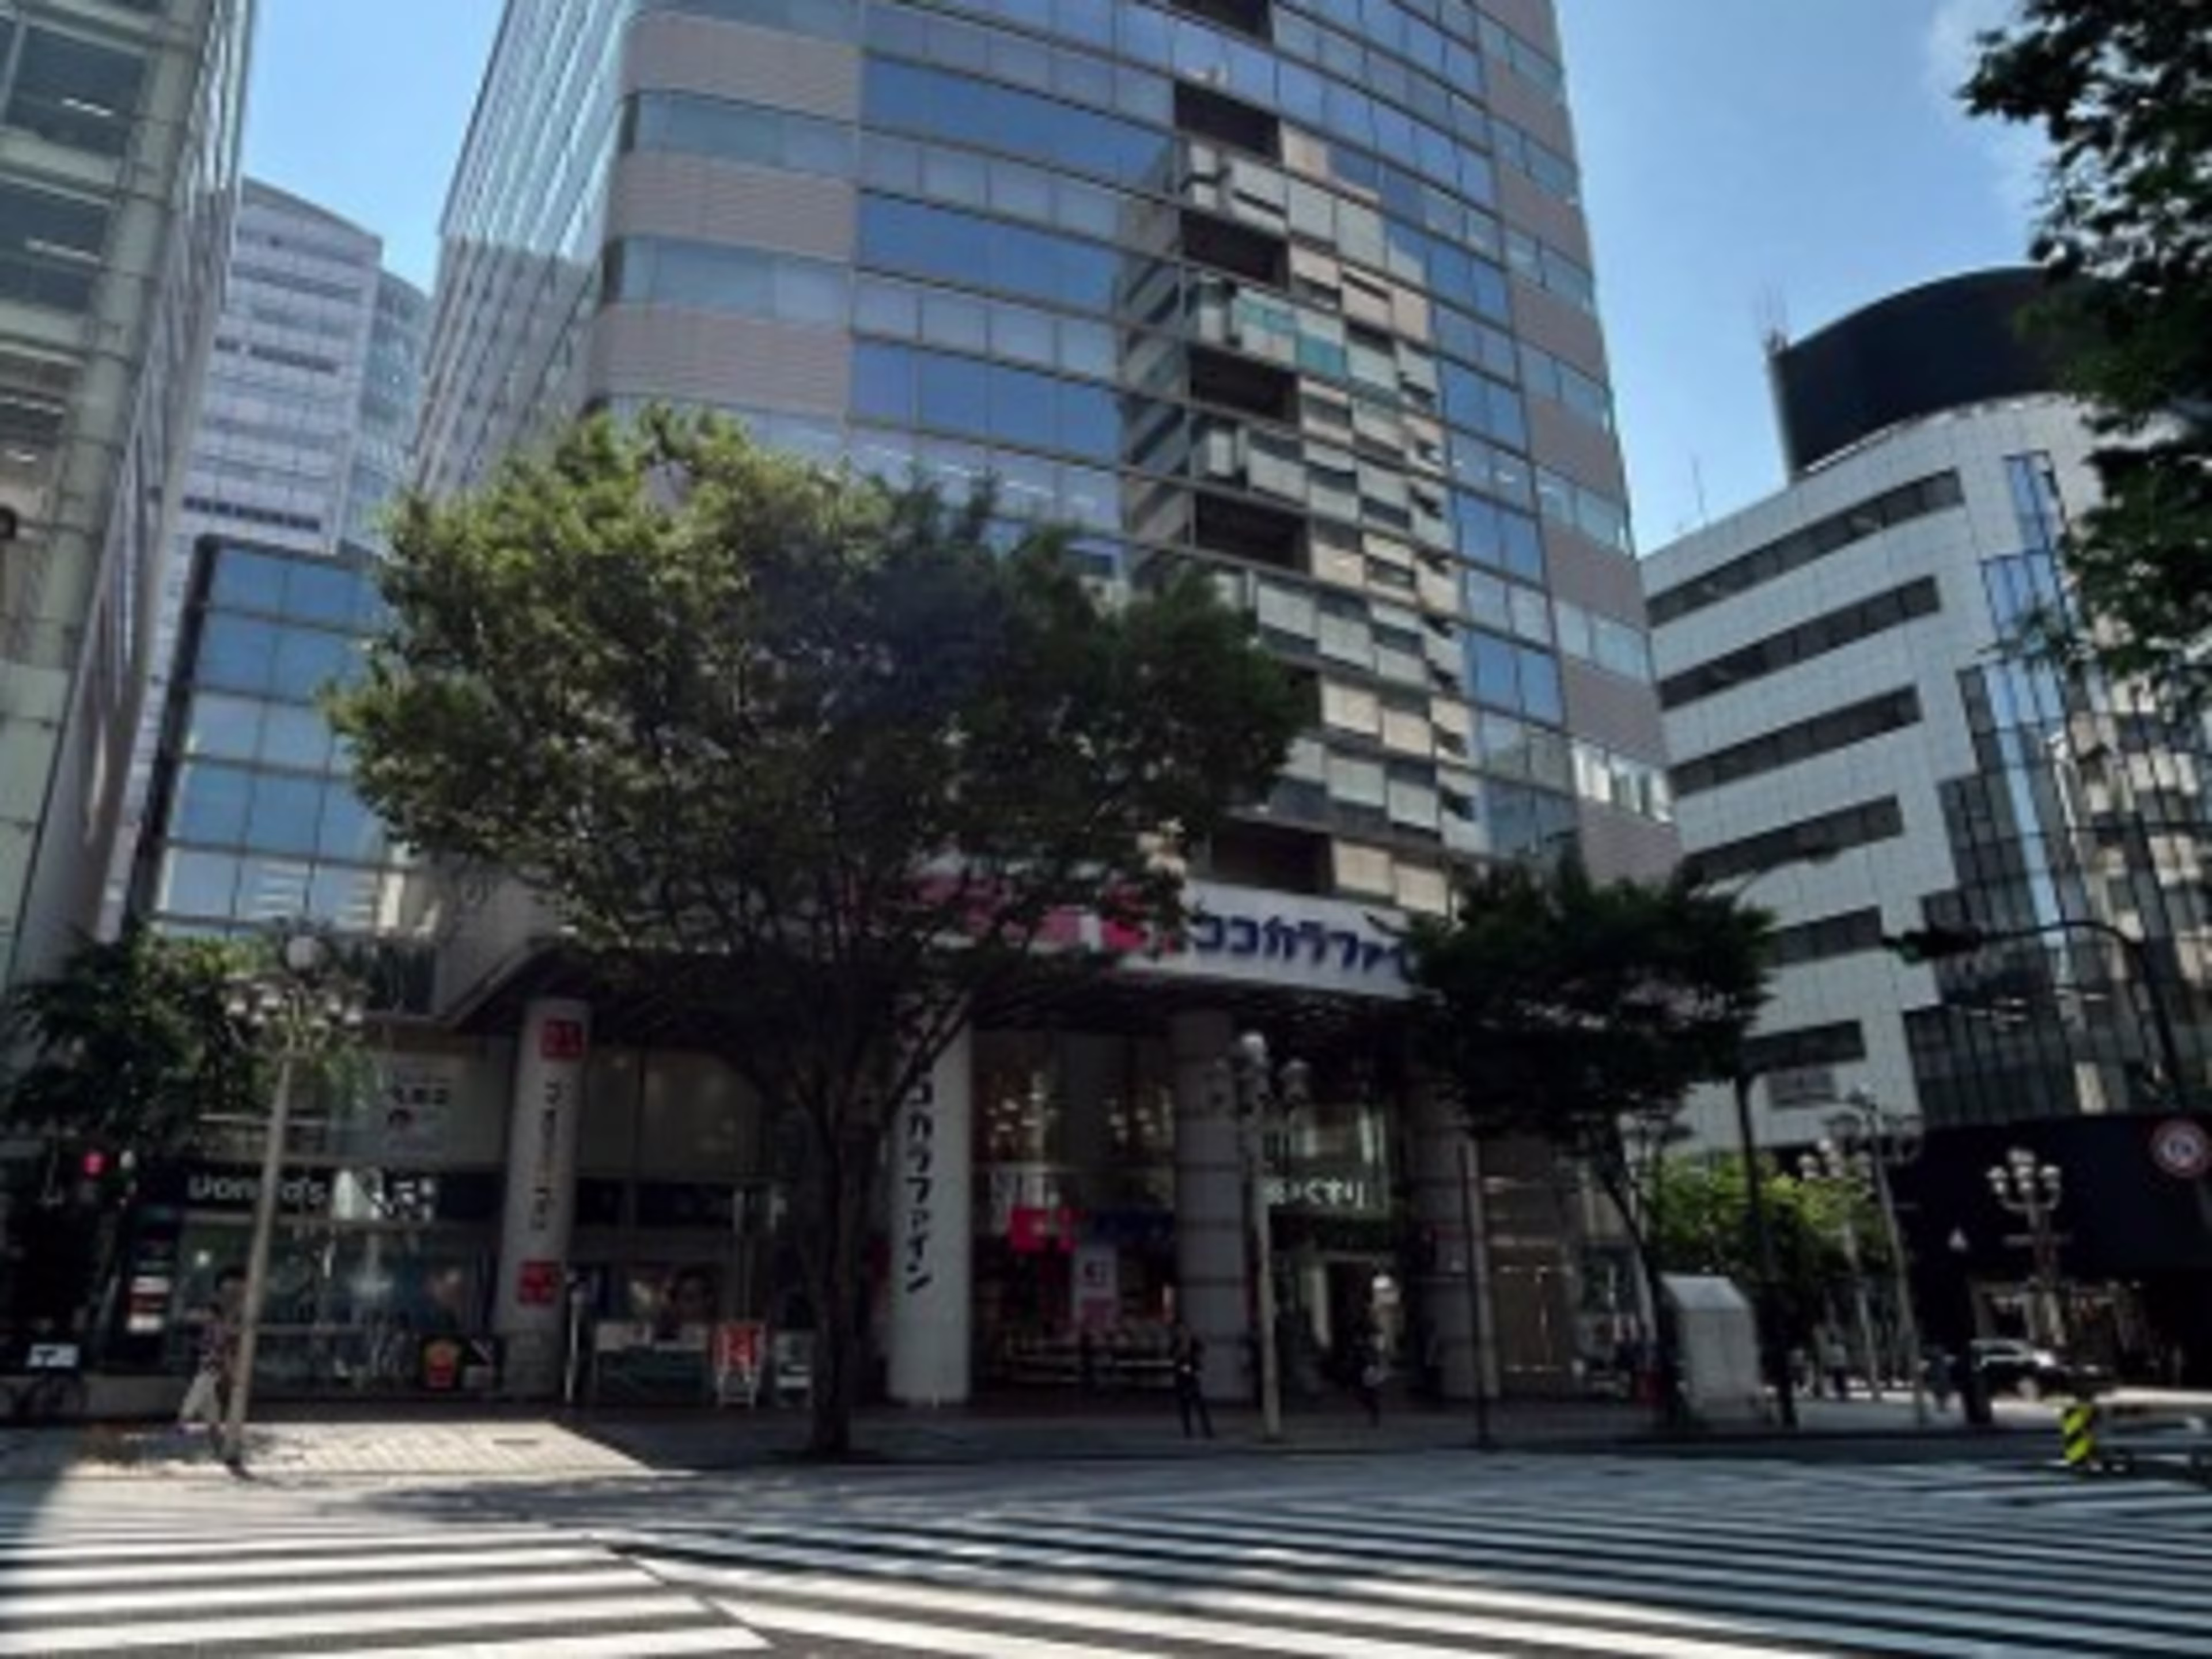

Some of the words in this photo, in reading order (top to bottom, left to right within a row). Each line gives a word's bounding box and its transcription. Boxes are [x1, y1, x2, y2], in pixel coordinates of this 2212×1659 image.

[906, 1059, 933, 1293] コカラファイン
